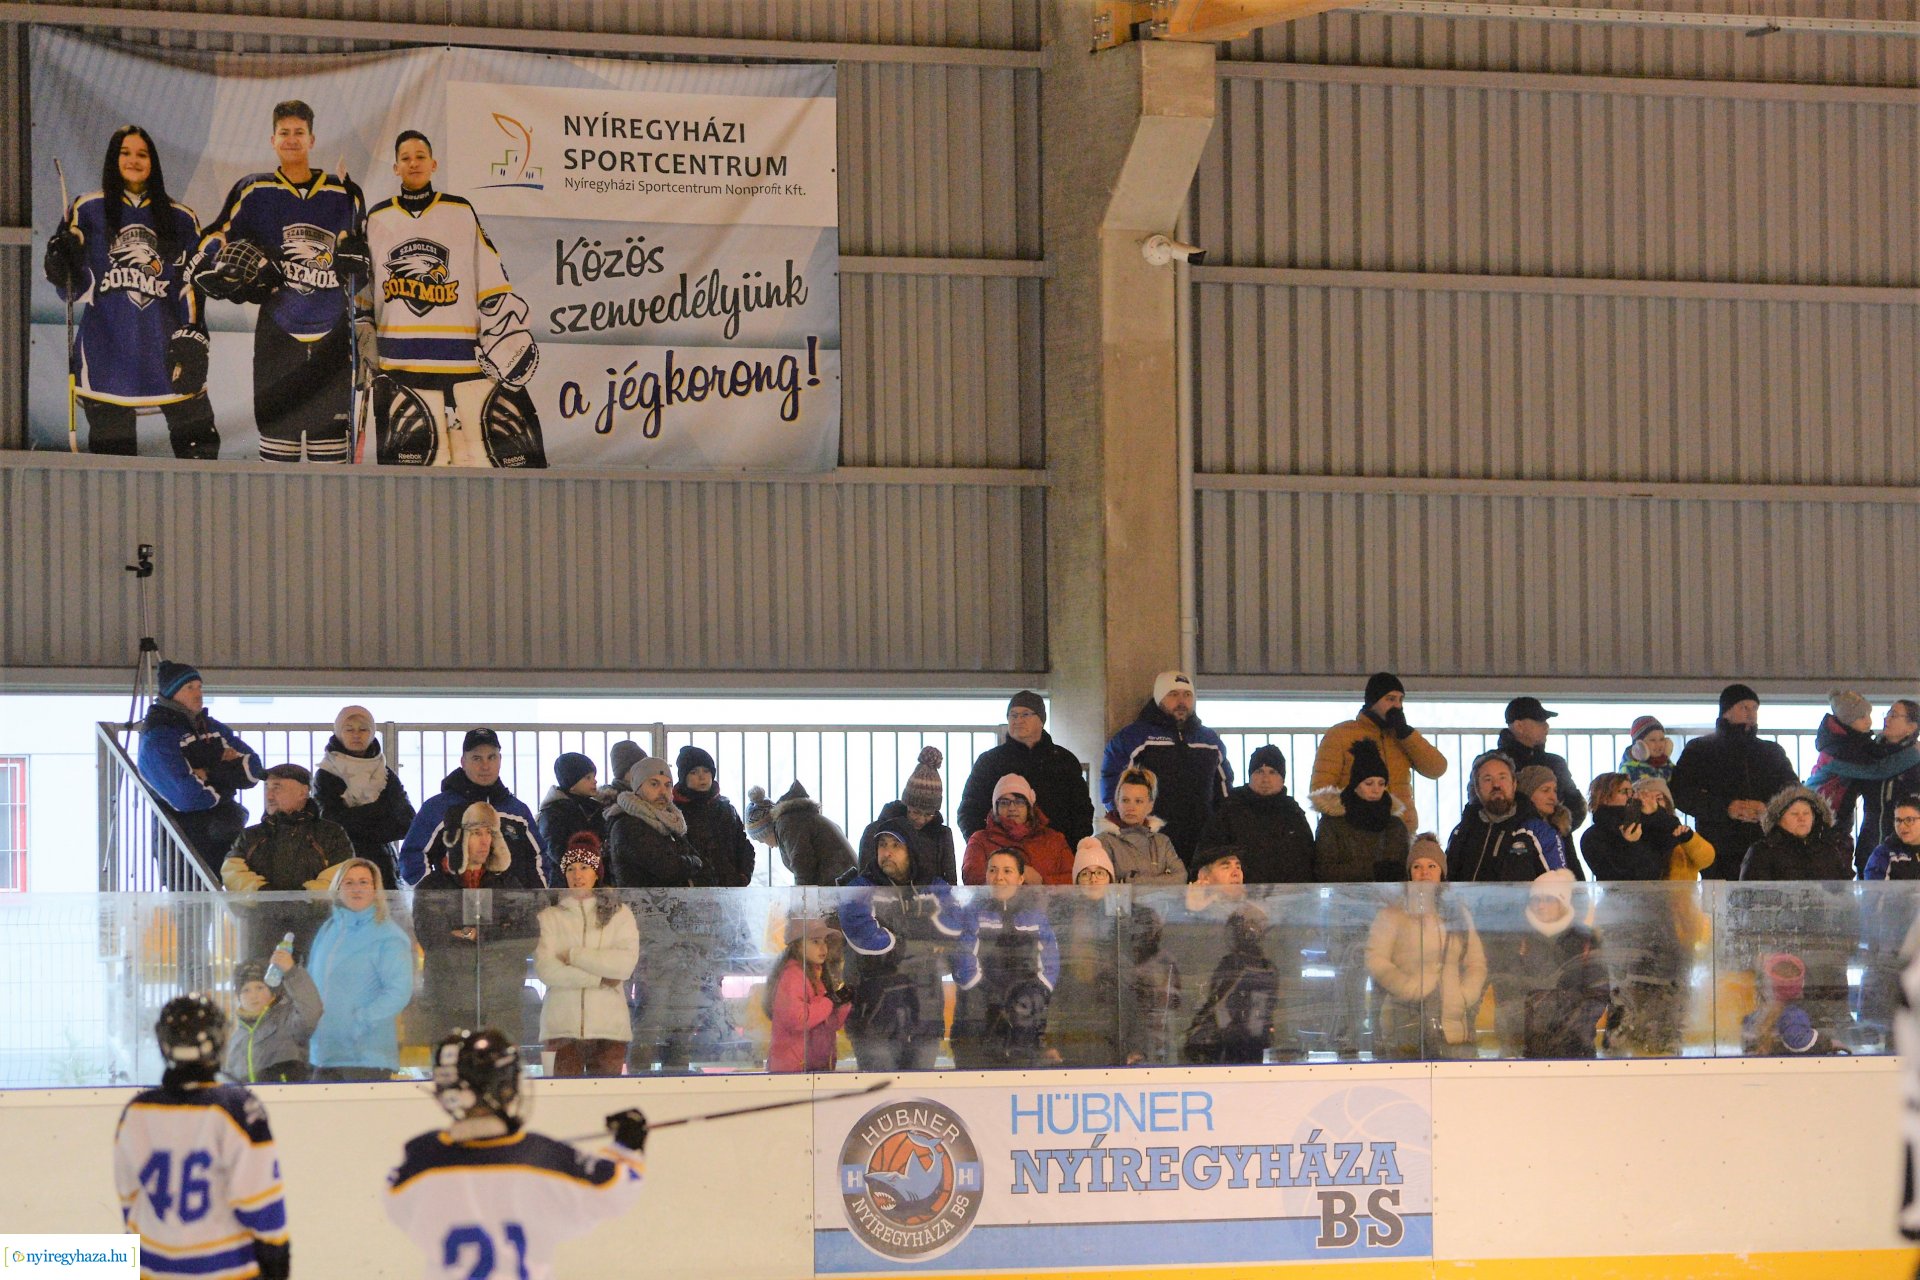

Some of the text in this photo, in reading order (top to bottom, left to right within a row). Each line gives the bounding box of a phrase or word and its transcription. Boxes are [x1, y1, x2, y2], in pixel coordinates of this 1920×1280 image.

[564, 111, 745, 144] NYÍREGYHÁZI
[564, 148, 787, 177] SPORTCENTRUM
[565, 177, 806, 197] Nyíregyházi Sportcentrum Nonprofit Kft.
[556, 236, 664, 286] Közös
[383, 273, 459, 306] SÓLYMOK
[550, 259, 808, 340] szenvedélyünk
[559, 335, 820, 438] a jégkorong!
[861, 1108, 960, 1147] HÜBNER
[1011, 1091, 1214, 1136] HÜBNER
[847, 1170, 863, 1188] H
[958, 1168, 973, 1186] H
[1011, 1129, 1404, 1195] NYÍREGYHÁZA
[138, 1149, 213, 1224] 46
[851, 1194, 970, 1248] NYÍREGYHÁZA BS
[1315, 1188, 1405, 1250] BS
[443, 1222, 529, 1280] 21
